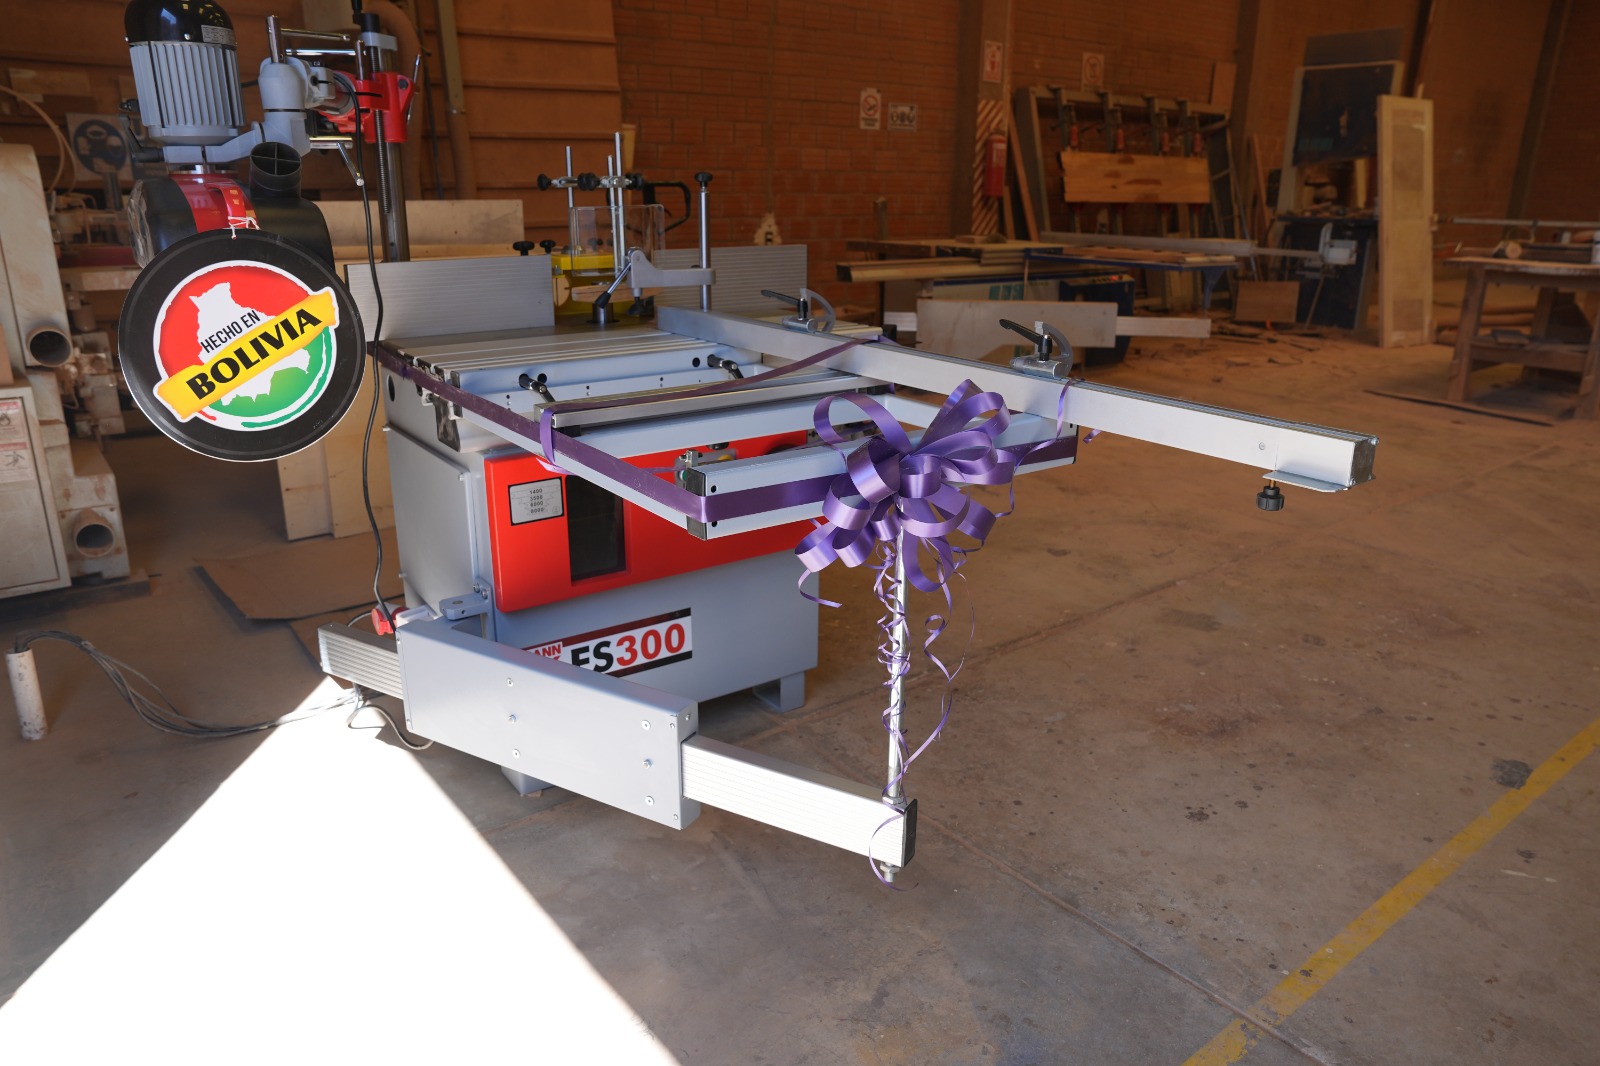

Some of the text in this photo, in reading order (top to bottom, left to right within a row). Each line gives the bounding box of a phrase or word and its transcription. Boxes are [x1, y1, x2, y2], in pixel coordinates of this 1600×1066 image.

[185, 308, 323, 401] BOLIVIA
[200, 310, 261, 354] HECHO EN
